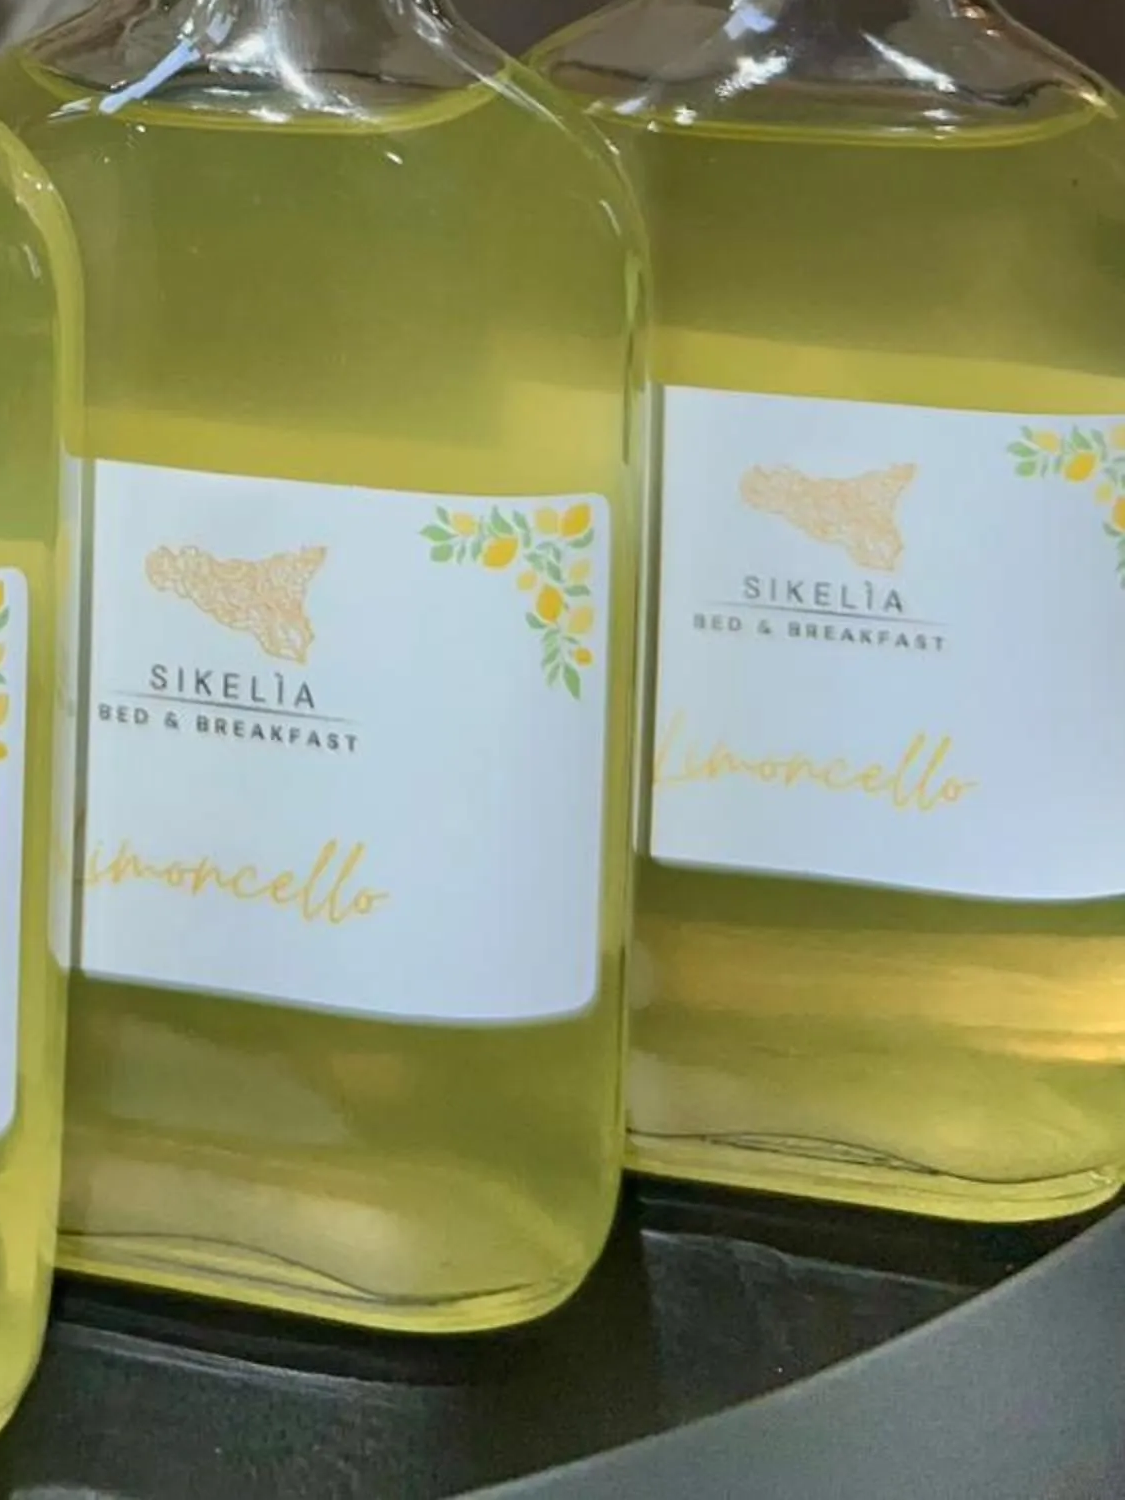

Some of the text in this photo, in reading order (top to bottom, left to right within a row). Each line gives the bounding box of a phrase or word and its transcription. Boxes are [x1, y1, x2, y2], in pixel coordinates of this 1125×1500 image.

[692, 612, 948, 653] BED & BREAKFAST
[97, 702, 360, 754] BED & BREAKFAST
[652, 707, 979, 812] Limoncello
[83, 836, 390, 926] imoncello
